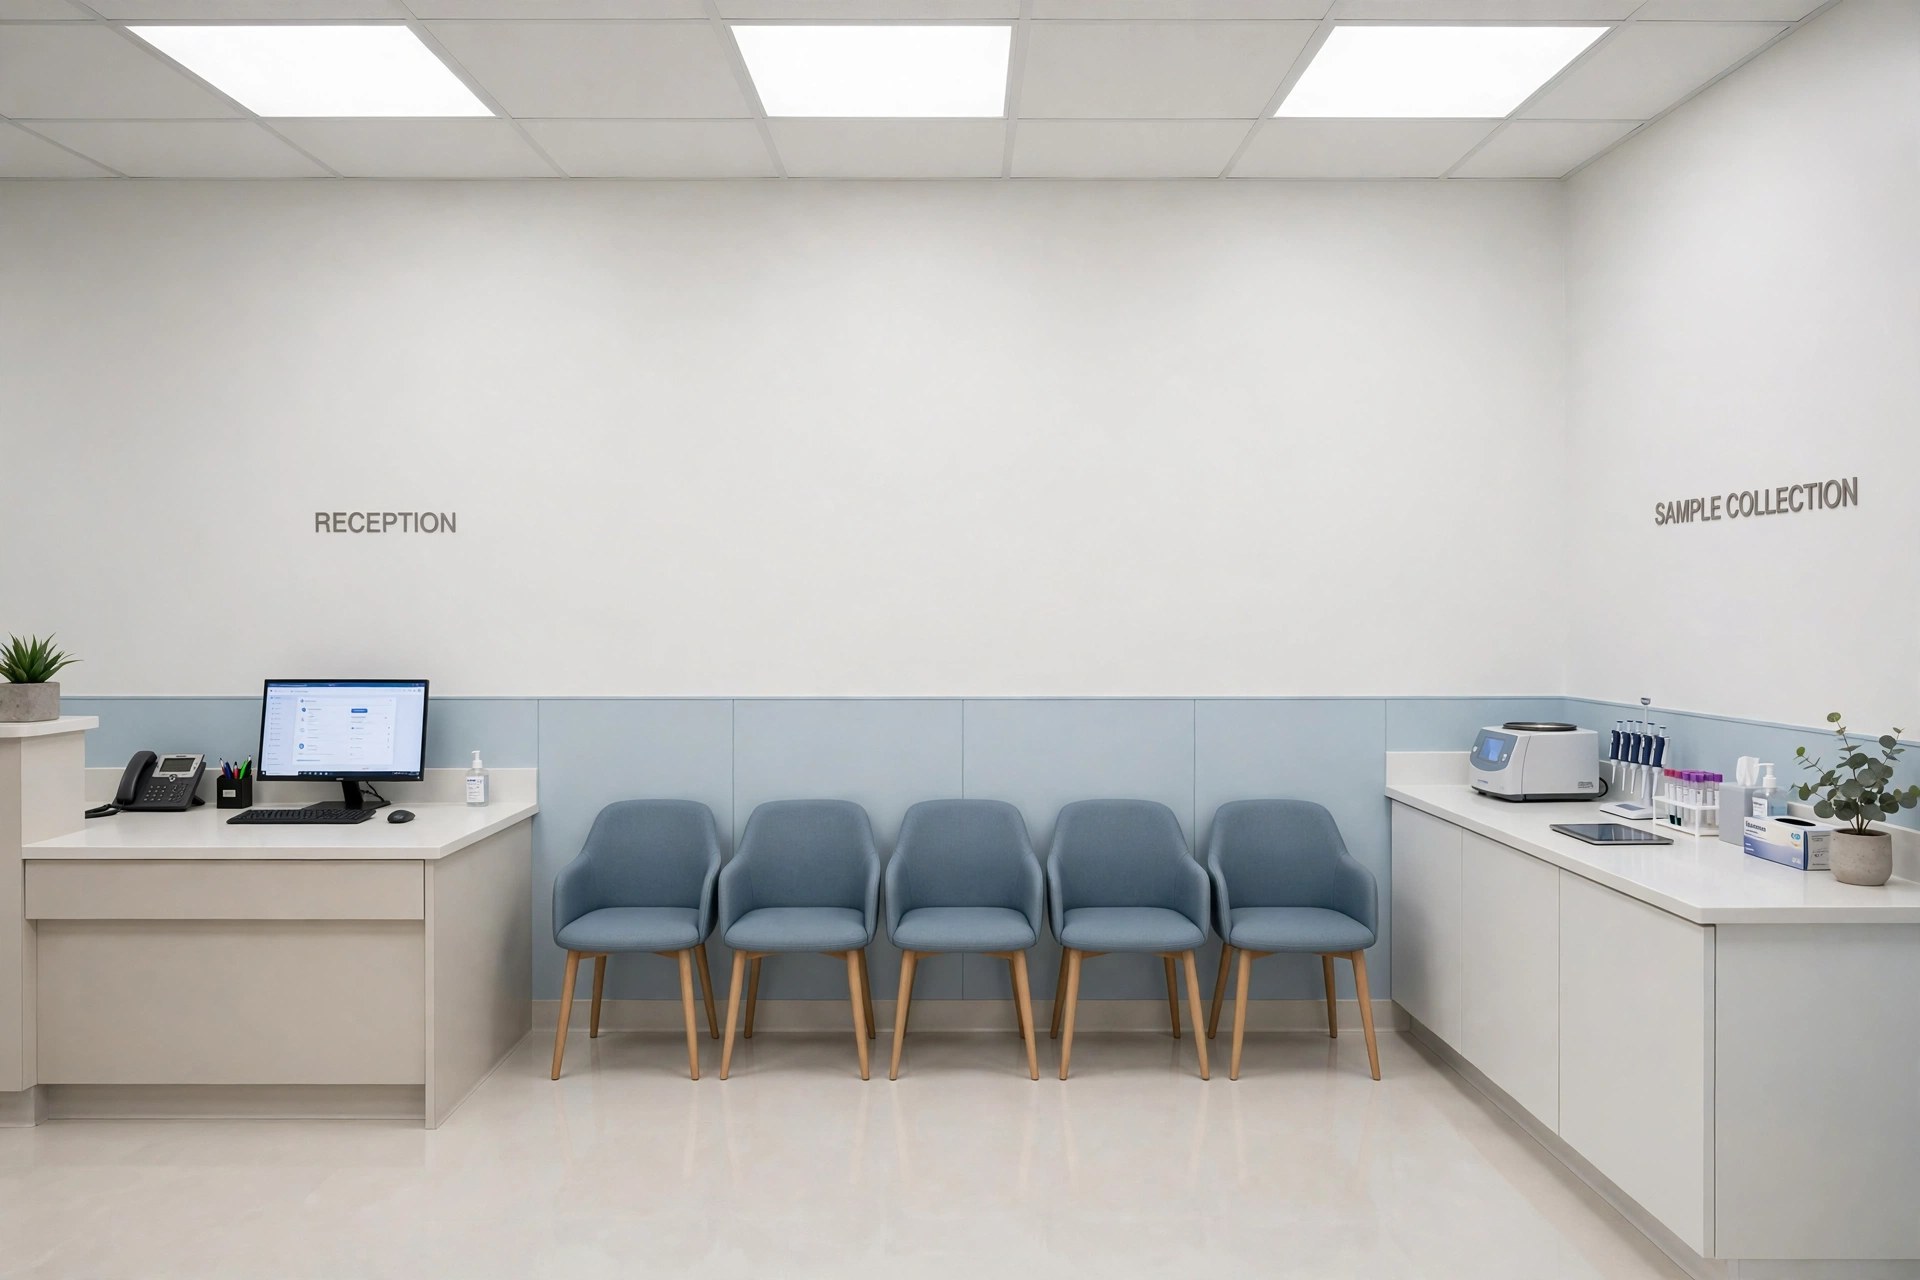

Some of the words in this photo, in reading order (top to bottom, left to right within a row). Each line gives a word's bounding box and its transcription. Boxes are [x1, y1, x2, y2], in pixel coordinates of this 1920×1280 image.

[1655, 495, 1721, 526] SAMPLE
[1726, 477, 1859, 519] COLLECTION
[315, 512, 457, 534] RECEPTION
